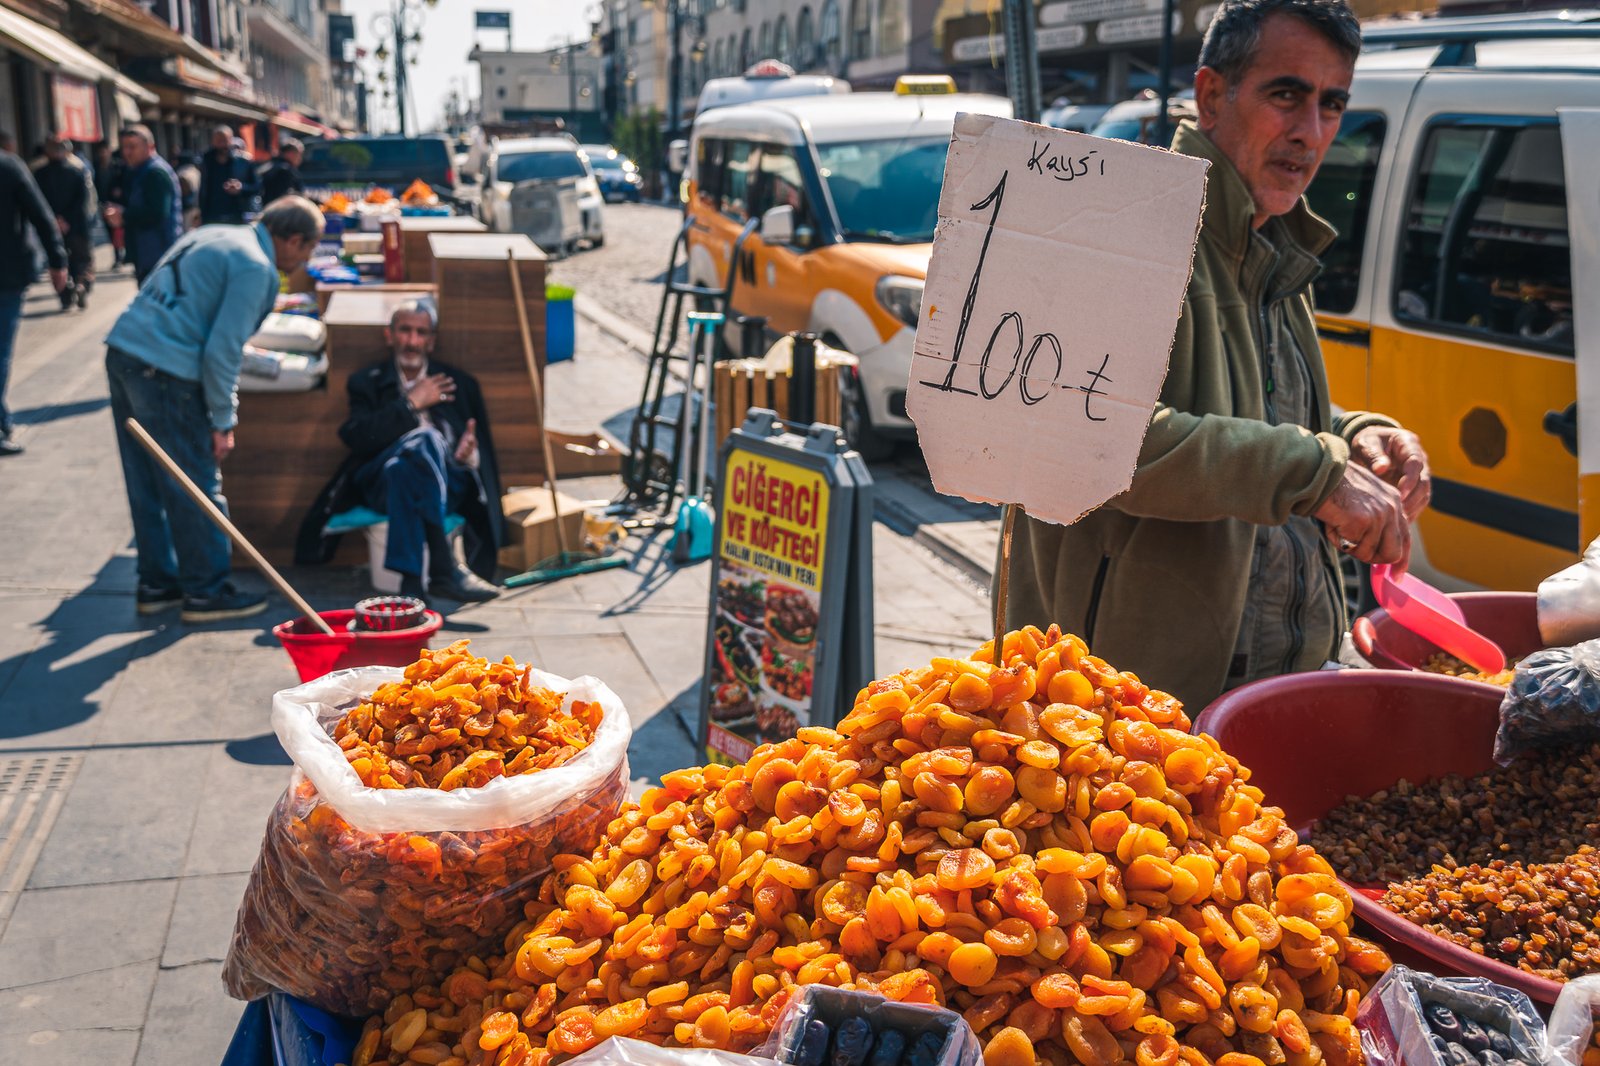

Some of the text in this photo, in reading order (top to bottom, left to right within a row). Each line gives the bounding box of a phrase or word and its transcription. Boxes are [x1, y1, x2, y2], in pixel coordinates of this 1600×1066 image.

[732, 461, 820, 530] CİĞERCİ
[726, 509, 820, 568] VE KÖFTECİ
